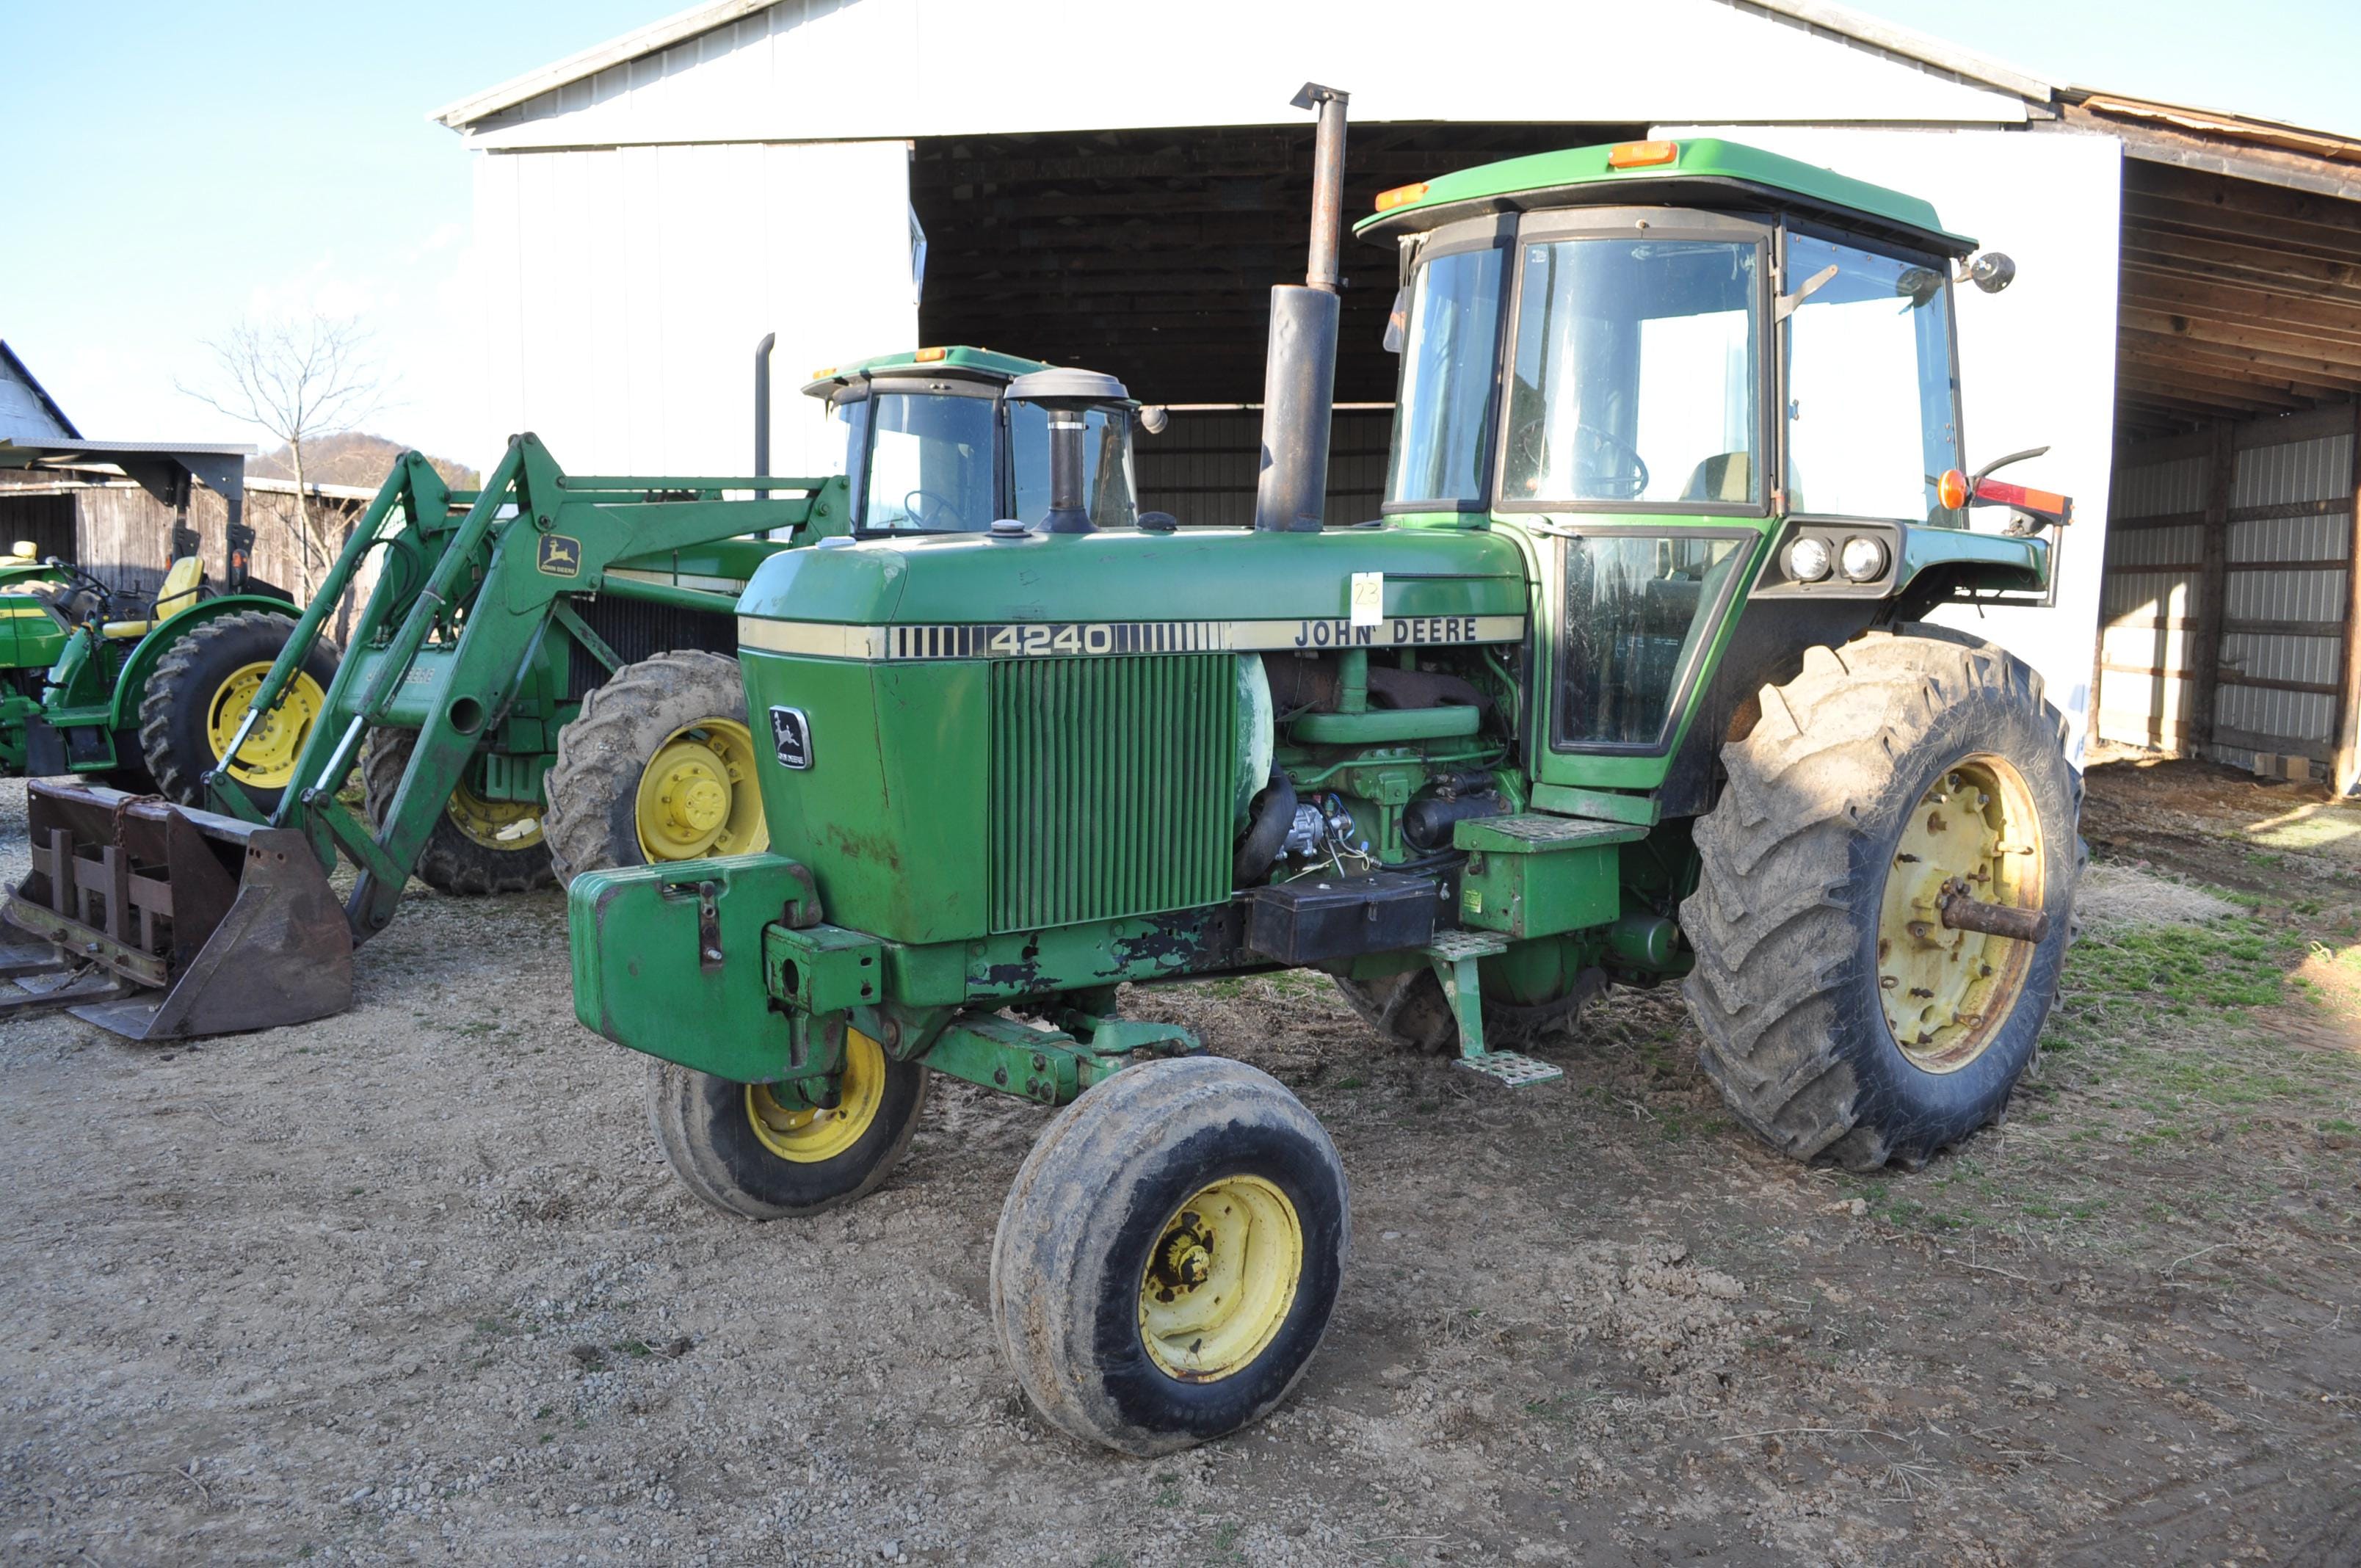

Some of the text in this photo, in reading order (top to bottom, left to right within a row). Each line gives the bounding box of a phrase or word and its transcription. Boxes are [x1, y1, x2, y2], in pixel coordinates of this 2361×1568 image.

[557, 566, 576, 574] DEERE
[1354, 583, 1379, 605] 23
[991, 625, 1112, 656] 4240
[1295, 618, 1476, 646] JOHN DEERE
